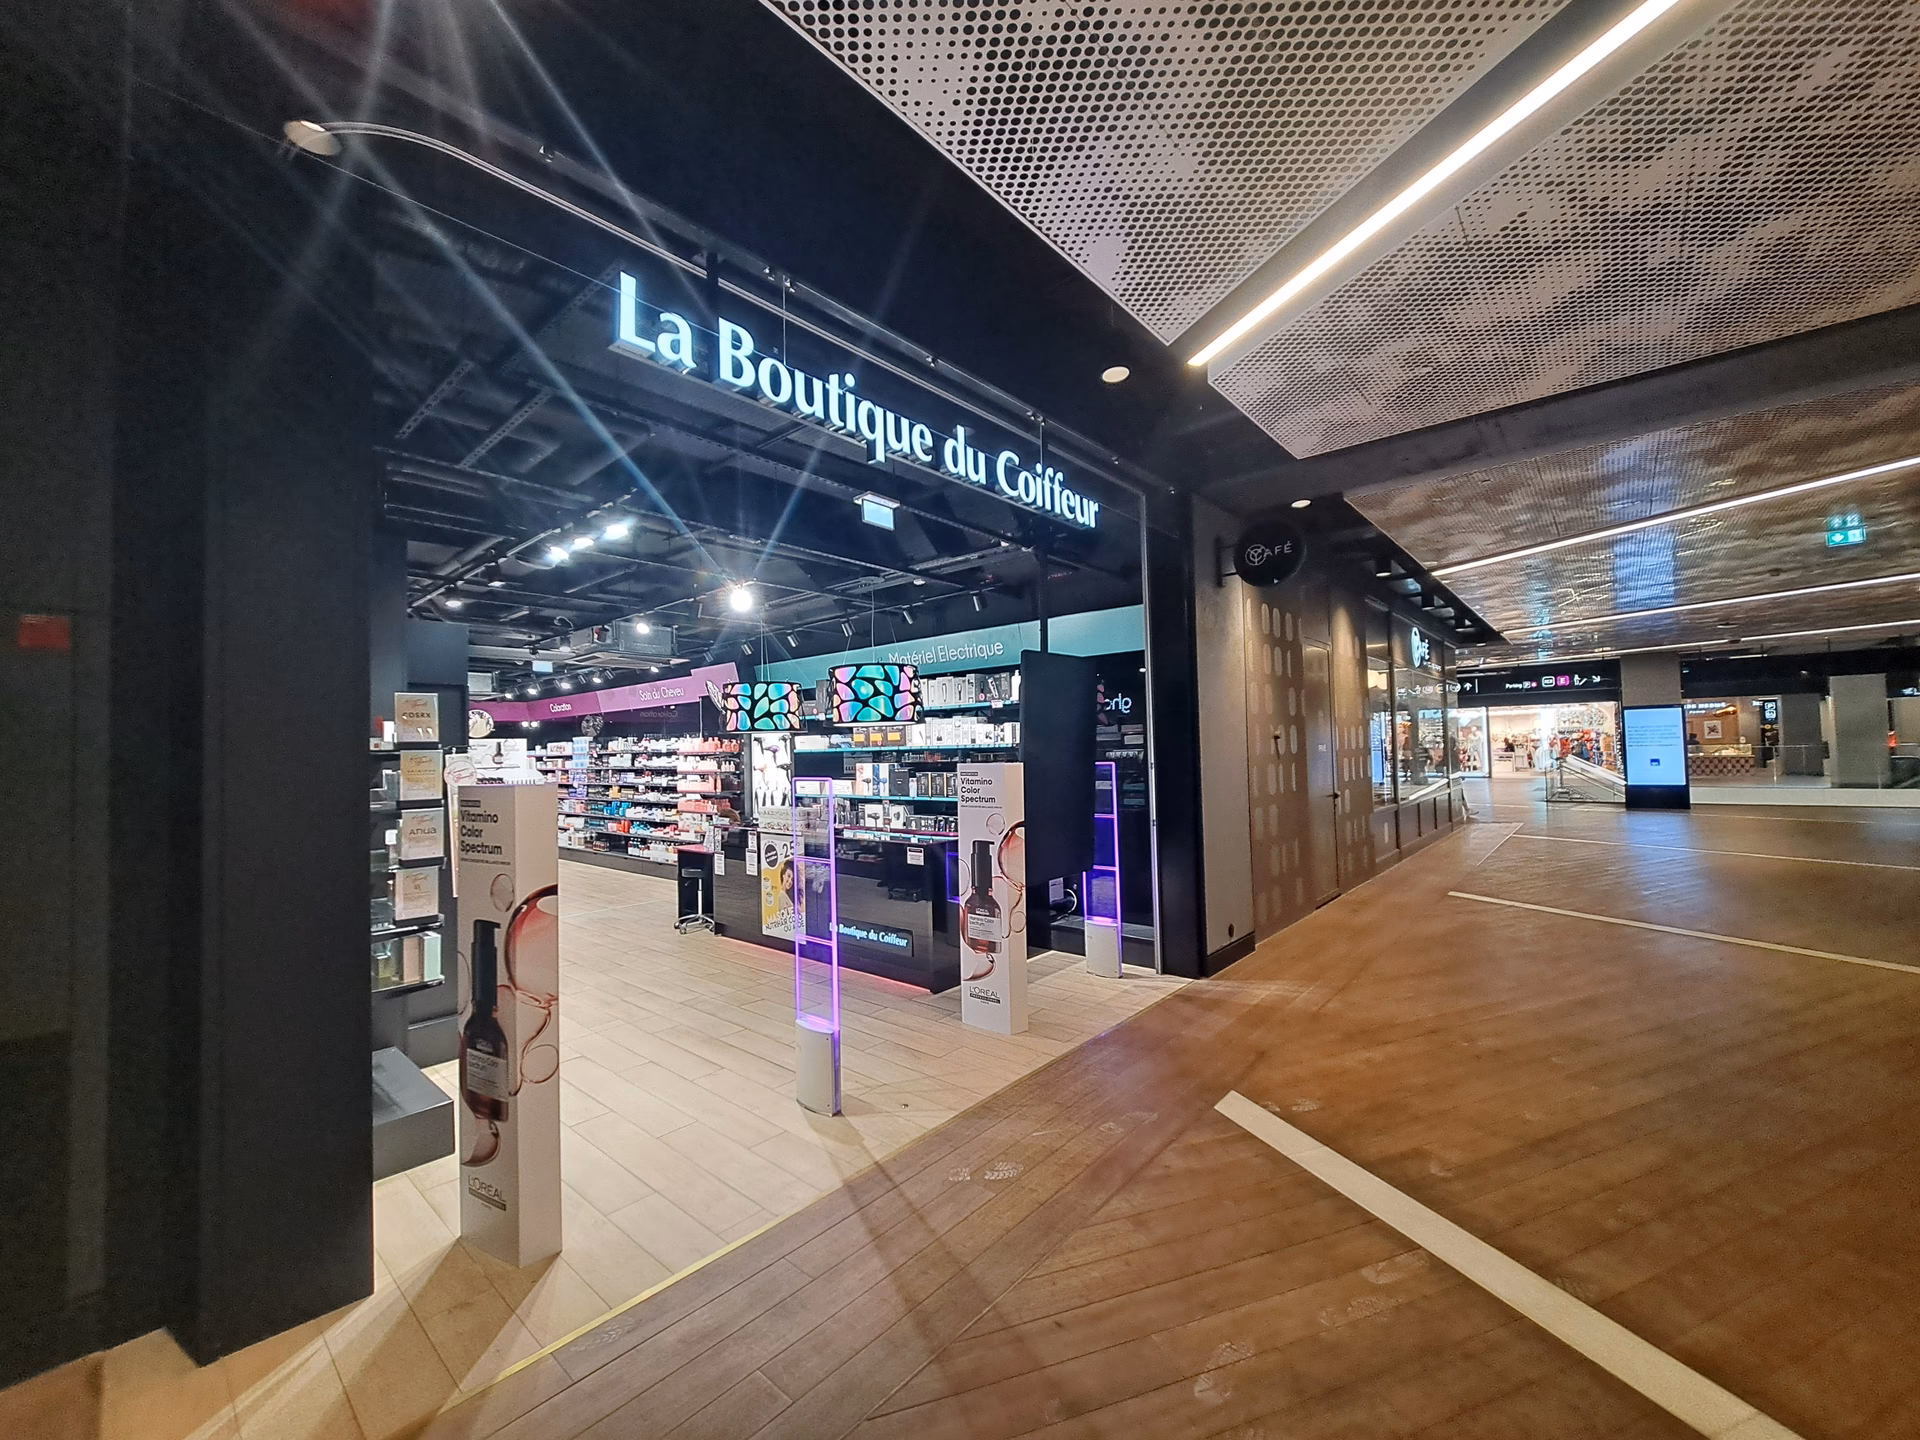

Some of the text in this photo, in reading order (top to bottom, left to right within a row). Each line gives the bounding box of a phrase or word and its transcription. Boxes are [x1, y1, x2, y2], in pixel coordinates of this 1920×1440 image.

[619, 270, 1099, 528] La Boutique du Coiffeur
[937, 641, 1004, 663] Electrique
[639, 689, 653, 702] Soin
[661, 685, 685, 699] Cheveu
[549, 702, 573, 713] Coloration
[960, 777, 993, 786] Vitamino
[960, 786, 981, 794] Color
[960, 794, 996, 804] Spectrum
[460, 810, 499, 824] Vitamino
[460, 825, 483, 838] Color
[460, 840, 503, 855] Spectrum
[839, 923, 868, 940] Boutique
[868, 929, 878, 941] du
[879, 932, 908, 947] Coiffeur
